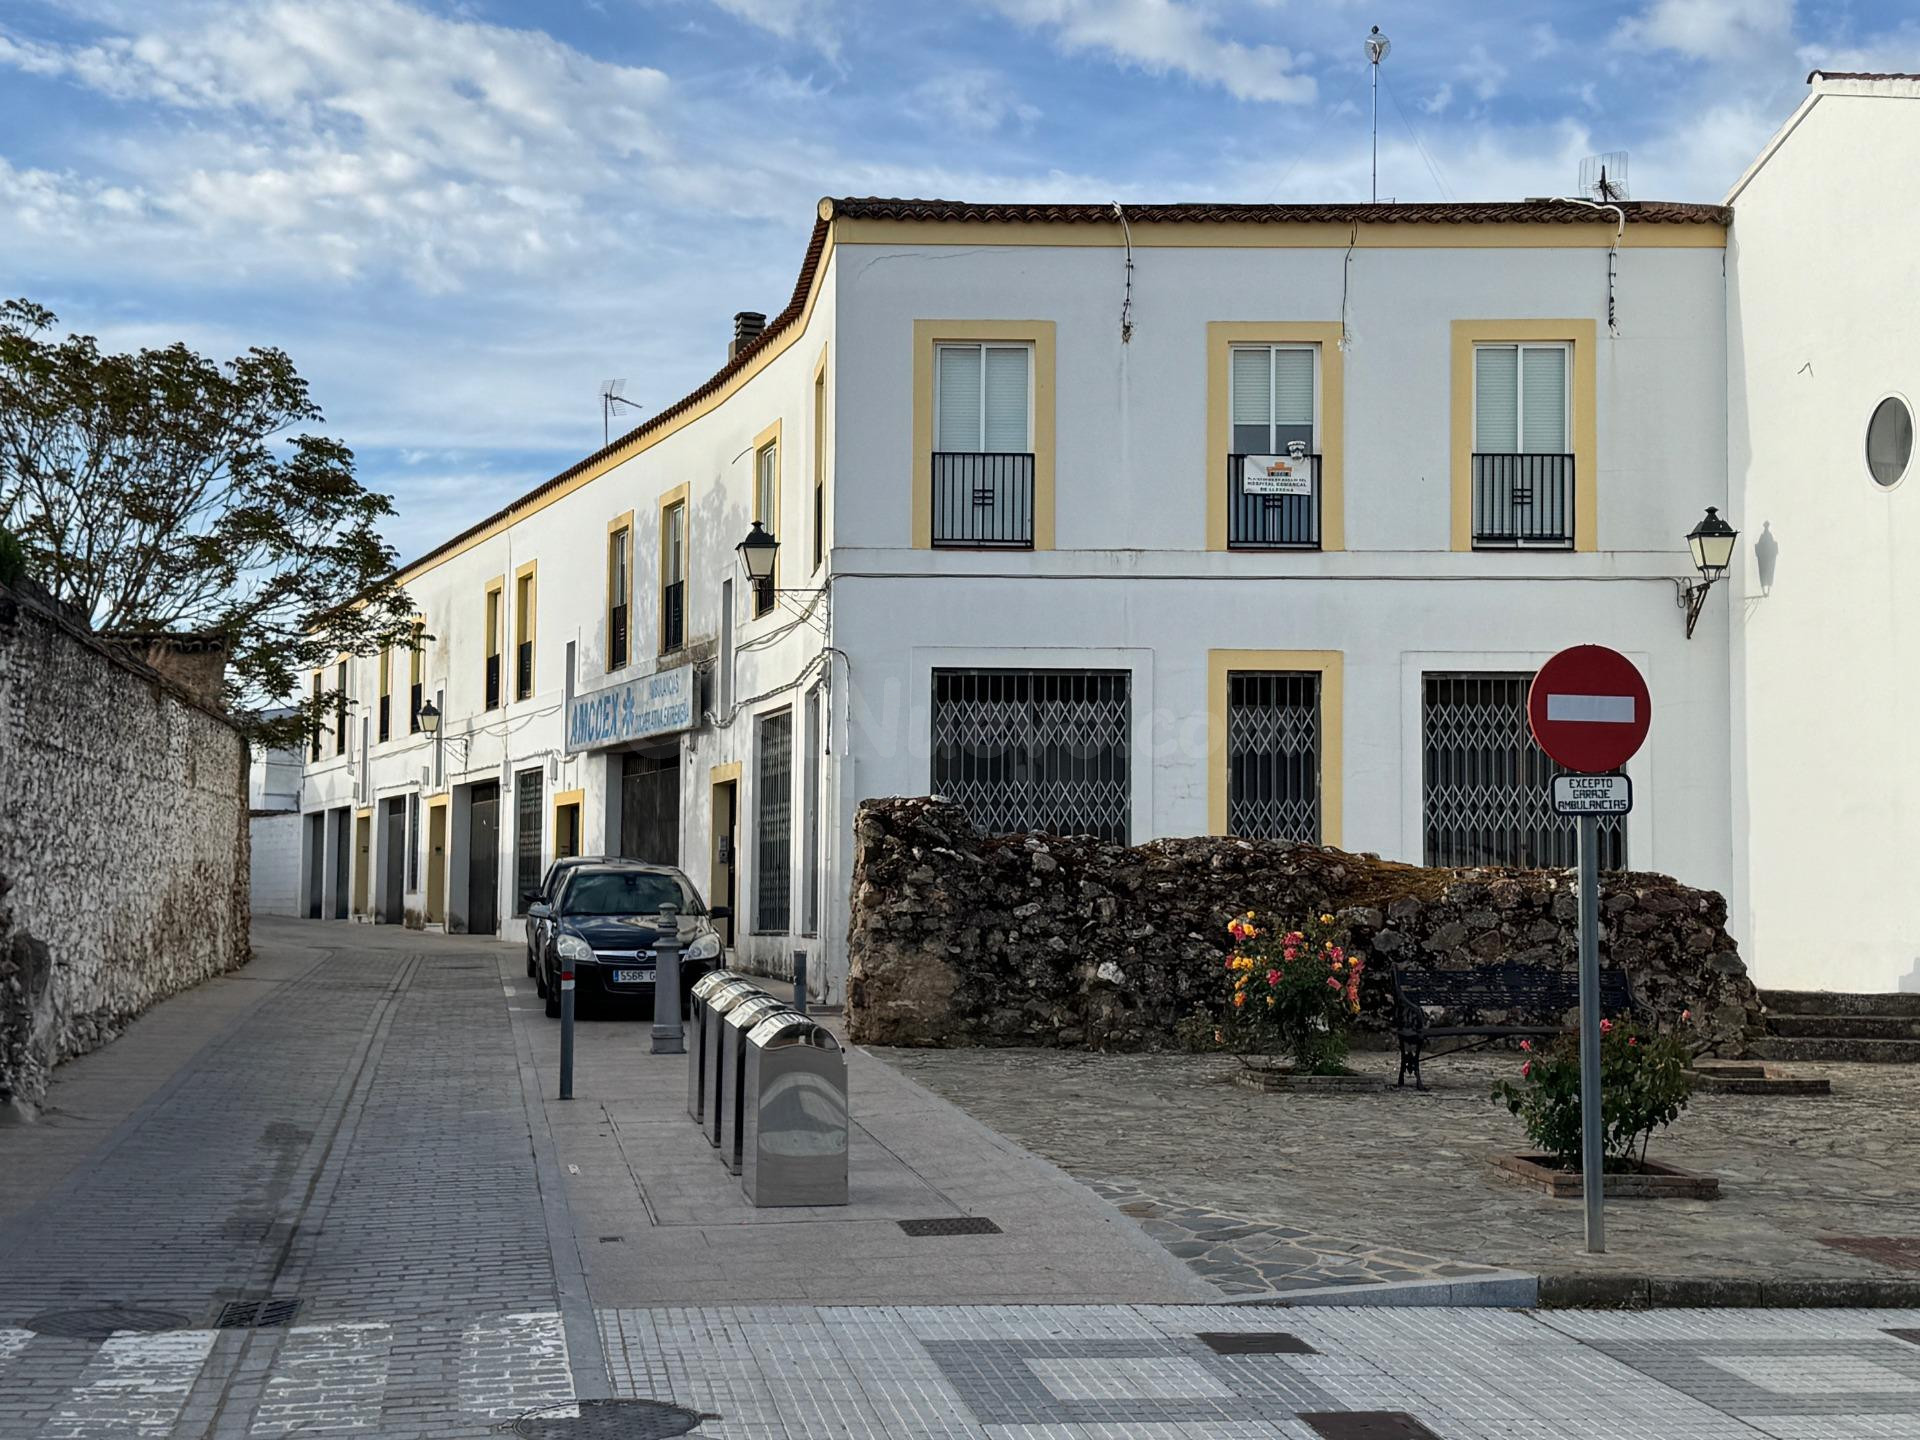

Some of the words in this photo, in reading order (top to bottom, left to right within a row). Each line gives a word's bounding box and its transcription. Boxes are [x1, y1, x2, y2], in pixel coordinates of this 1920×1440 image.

[570, 693, 618, 745] AMCOEX
[1569, 778, 1613, 788] EXCEPTO
[1573, 789, 1610, 799] GARAJE
[1558, 800, 1627, 810] AMBULANCIAS
